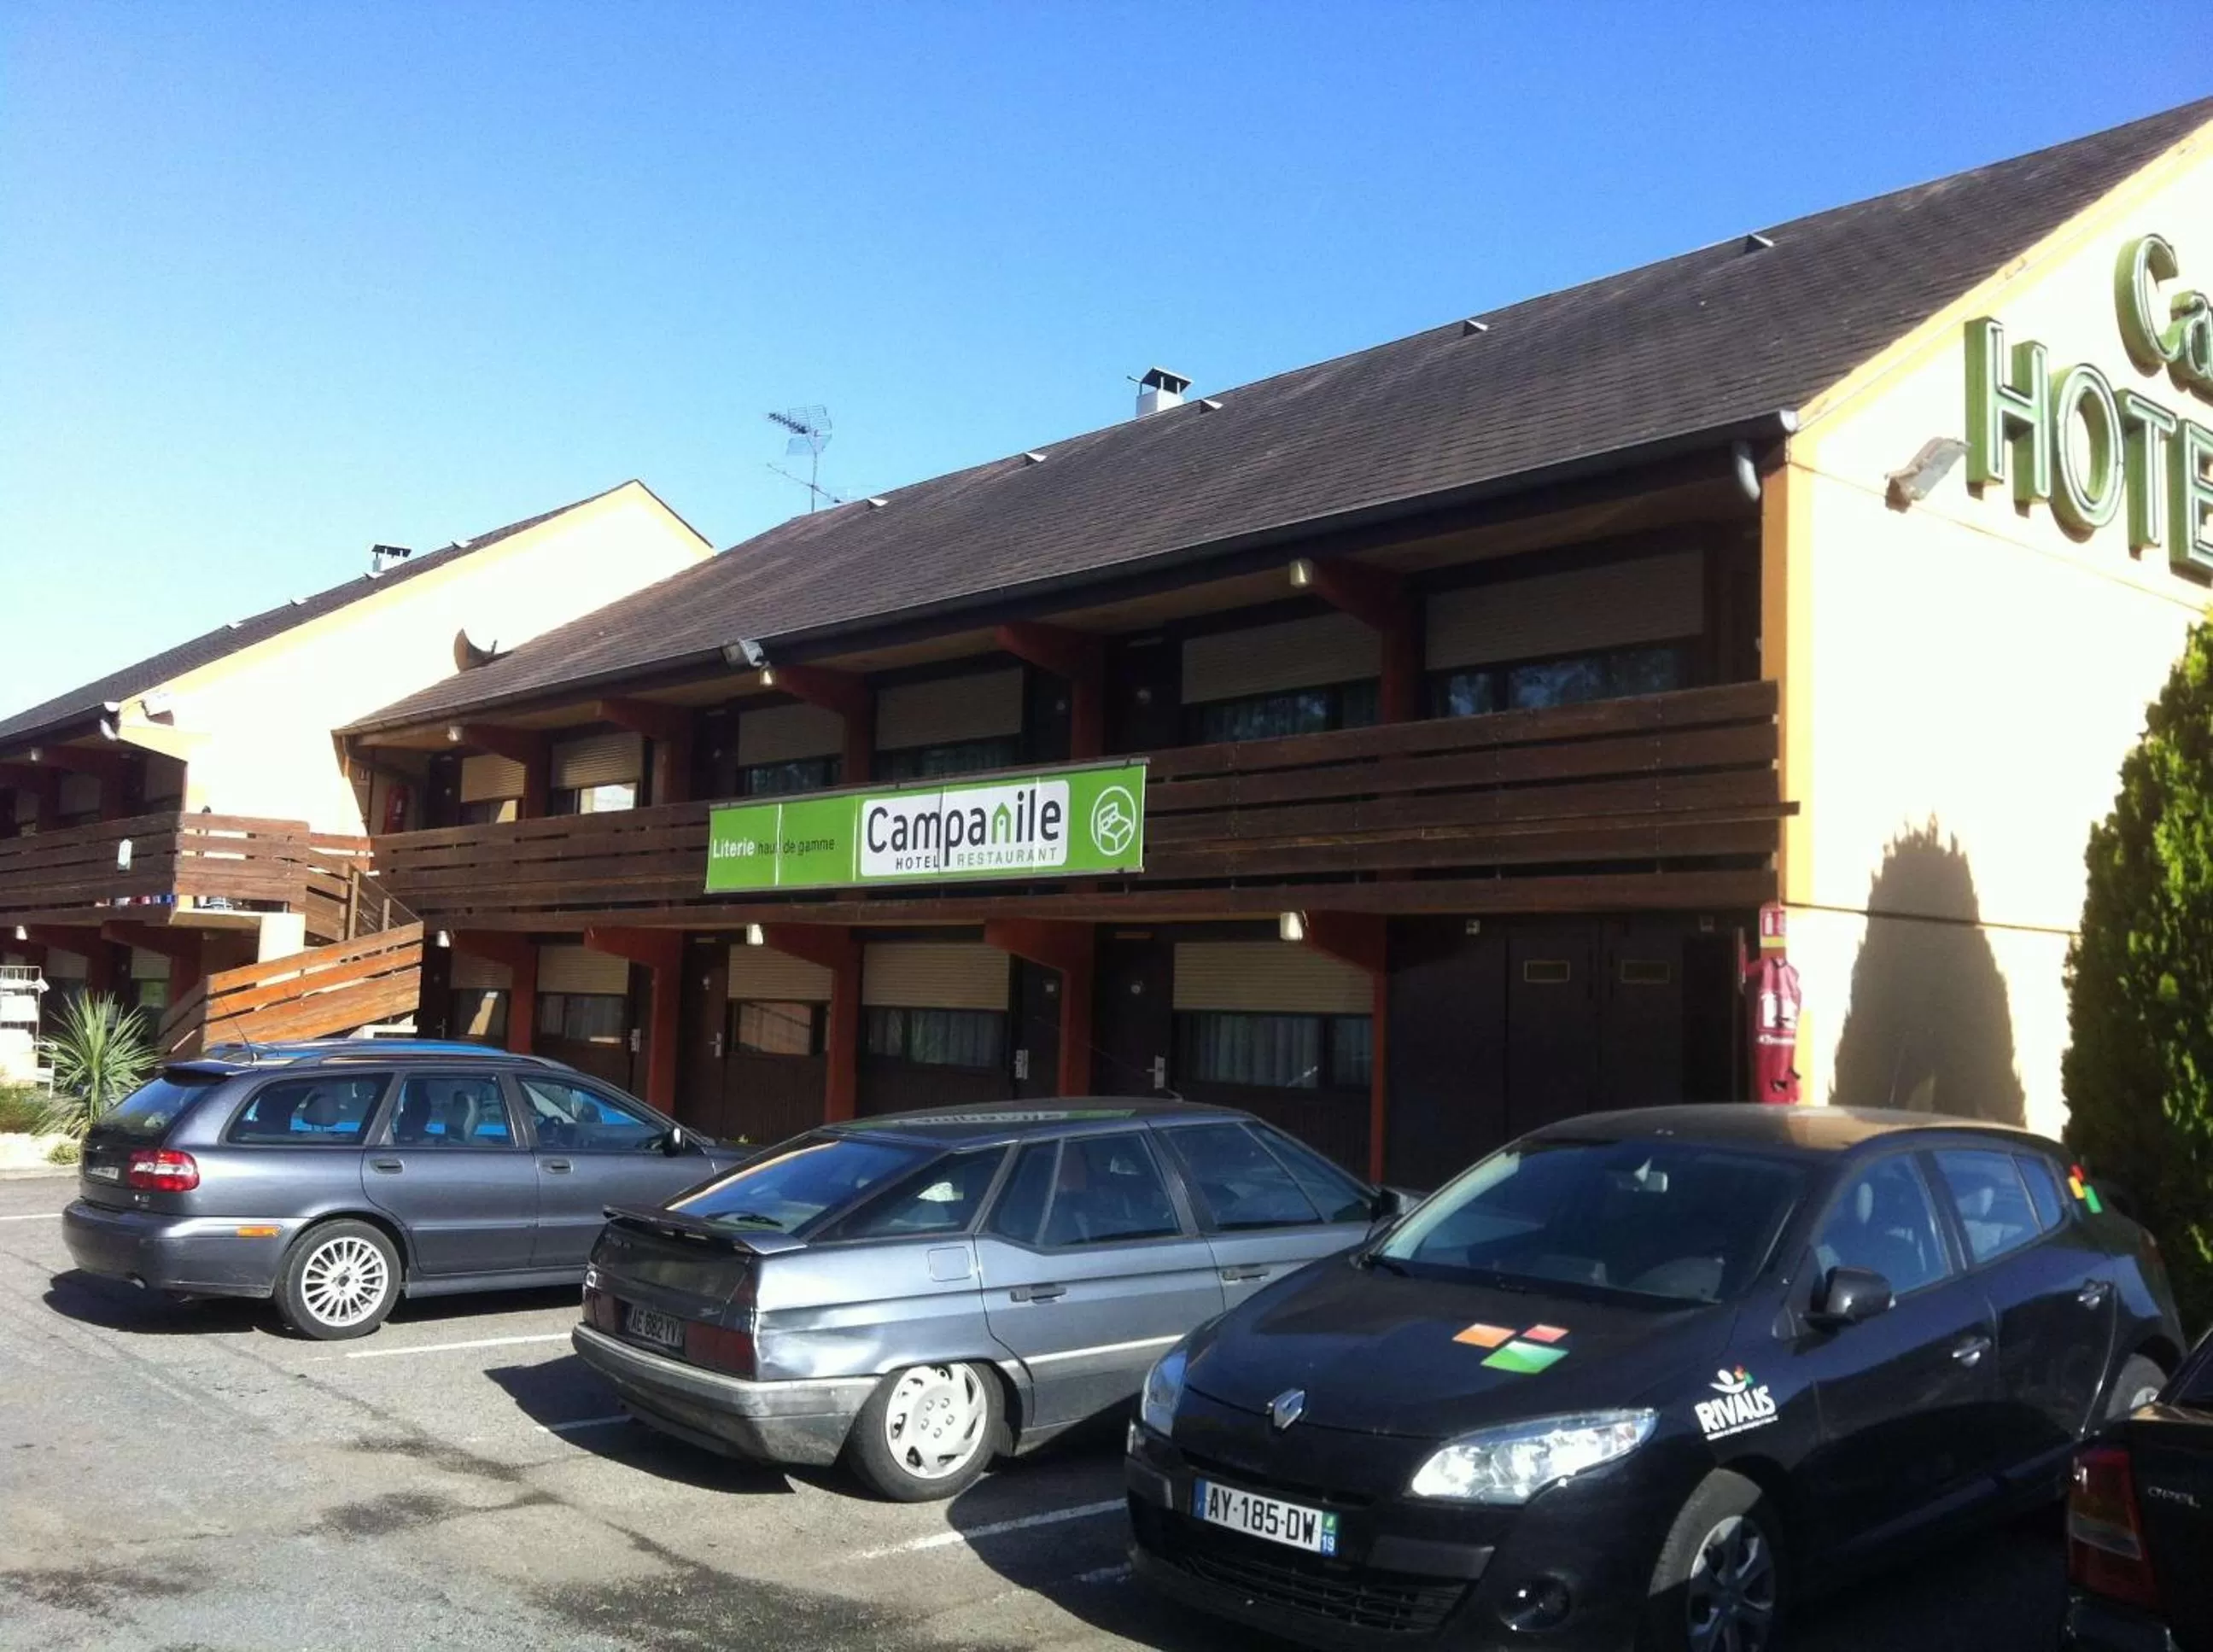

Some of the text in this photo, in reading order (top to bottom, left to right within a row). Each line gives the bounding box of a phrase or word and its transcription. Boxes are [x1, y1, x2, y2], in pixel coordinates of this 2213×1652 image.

[867, 789, 1061, 867] Campanile
[713, 837, 756, 859] Literie
[783, 838, 797, 855] de
[798, 838, 835, 856] gamme
[896, 846, 1058, 870] HOTEL RESTAURANT
[1207, 1486, 1316, 1545] AY-185-DW
[1322, 1534, 1335, 1552] 19
